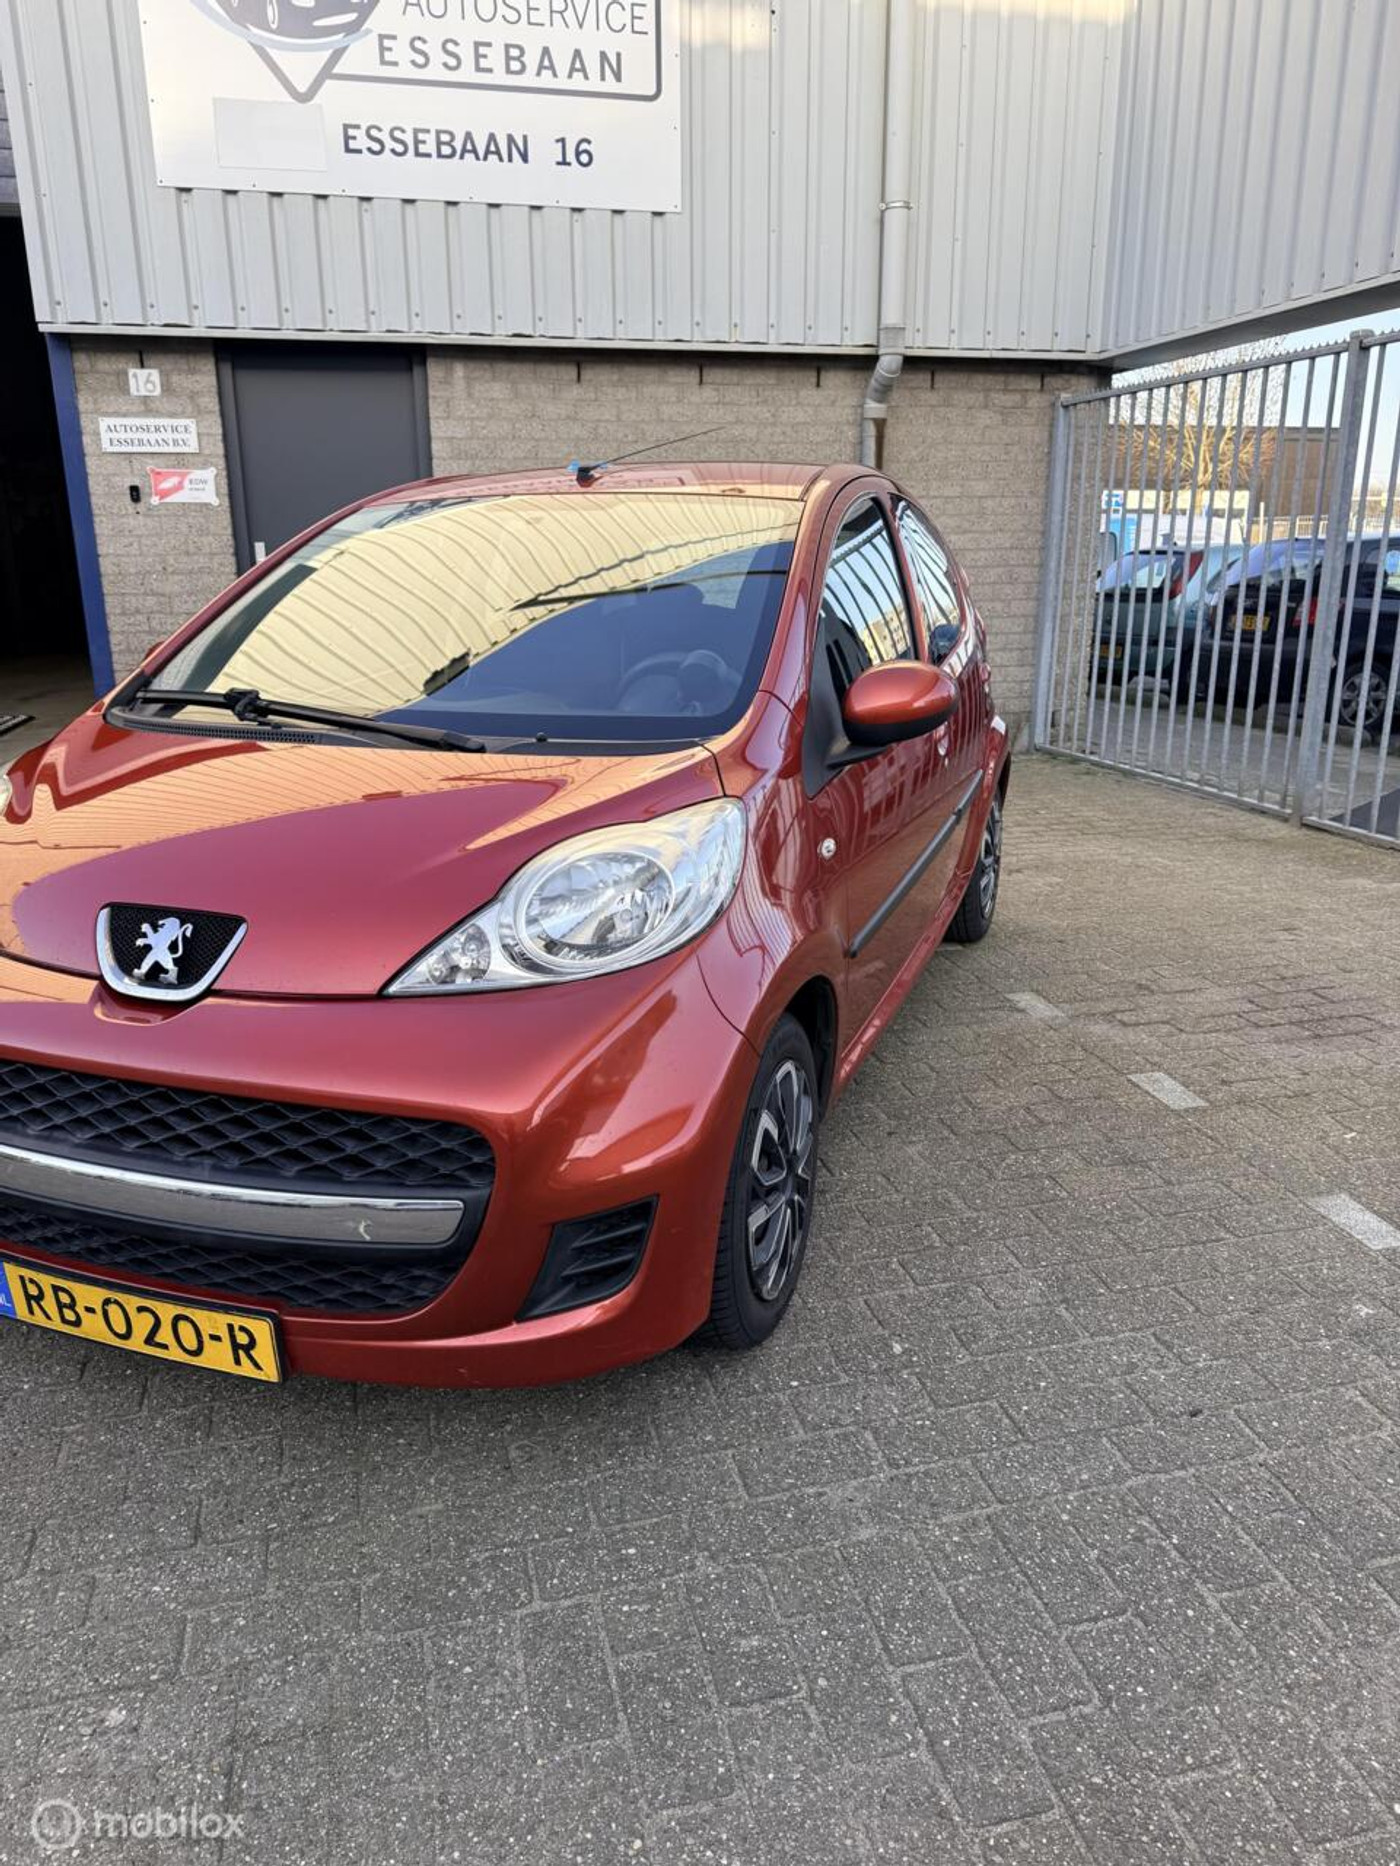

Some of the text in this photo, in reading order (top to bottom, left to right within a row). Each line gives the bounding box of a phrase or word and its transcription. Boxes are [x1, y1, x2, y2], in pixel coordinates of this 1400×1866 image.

[402, 0, 649, 35] AUTOSERVICE
[376, 33, 623, 83] ESSEBAAN
[341, 122, 594, 168] ESSEBAAN 16
[131, 371, 157, 393] 16
[105, 424, 192, 435] AUTOSERVICE
[109, 437, 191, 448] ESSEBAAN B.V.
[18, 1274, 265, 1373] RB-020-R
